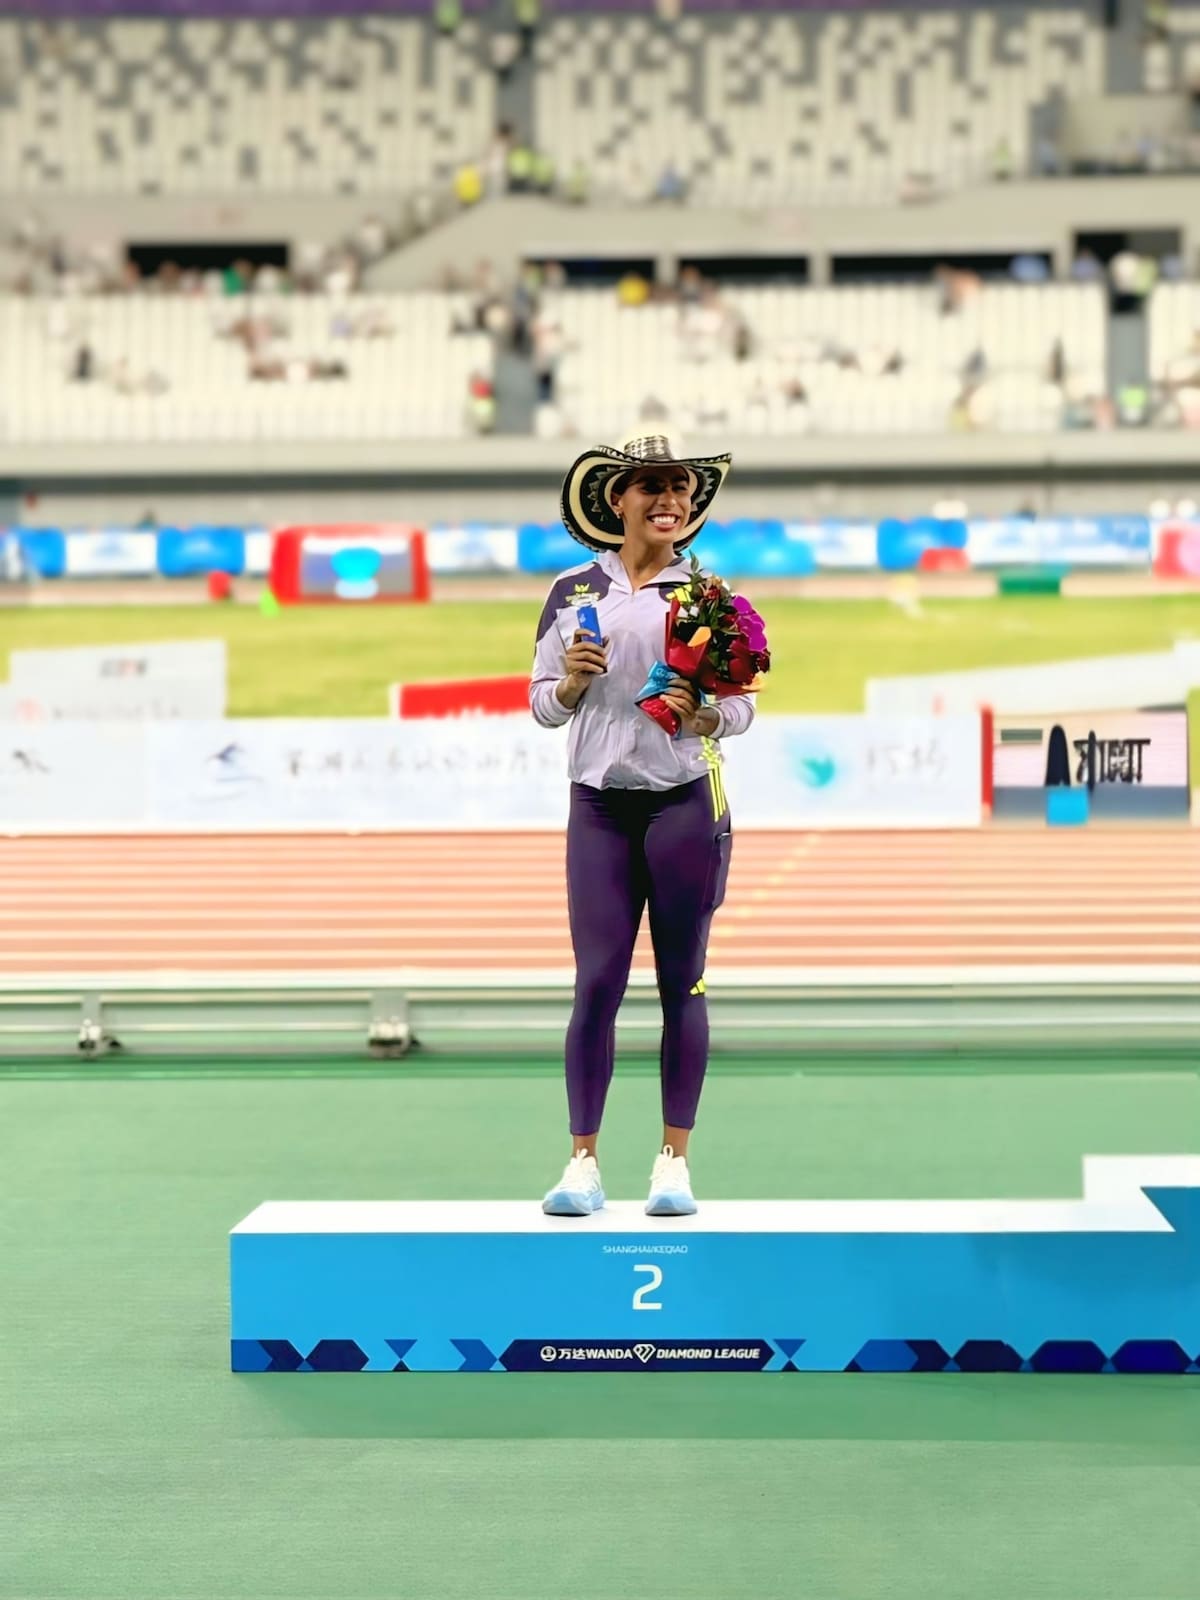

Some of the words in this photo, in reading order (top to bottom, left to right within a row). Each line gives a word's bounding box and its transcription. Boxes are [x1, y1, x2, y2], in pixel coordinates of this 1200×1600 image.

[632, 1264, 663, 1310] 2
[656, 1348, 712, 1359] DIAMOND
[714, 1348, 760, 1359] LEAGUE
